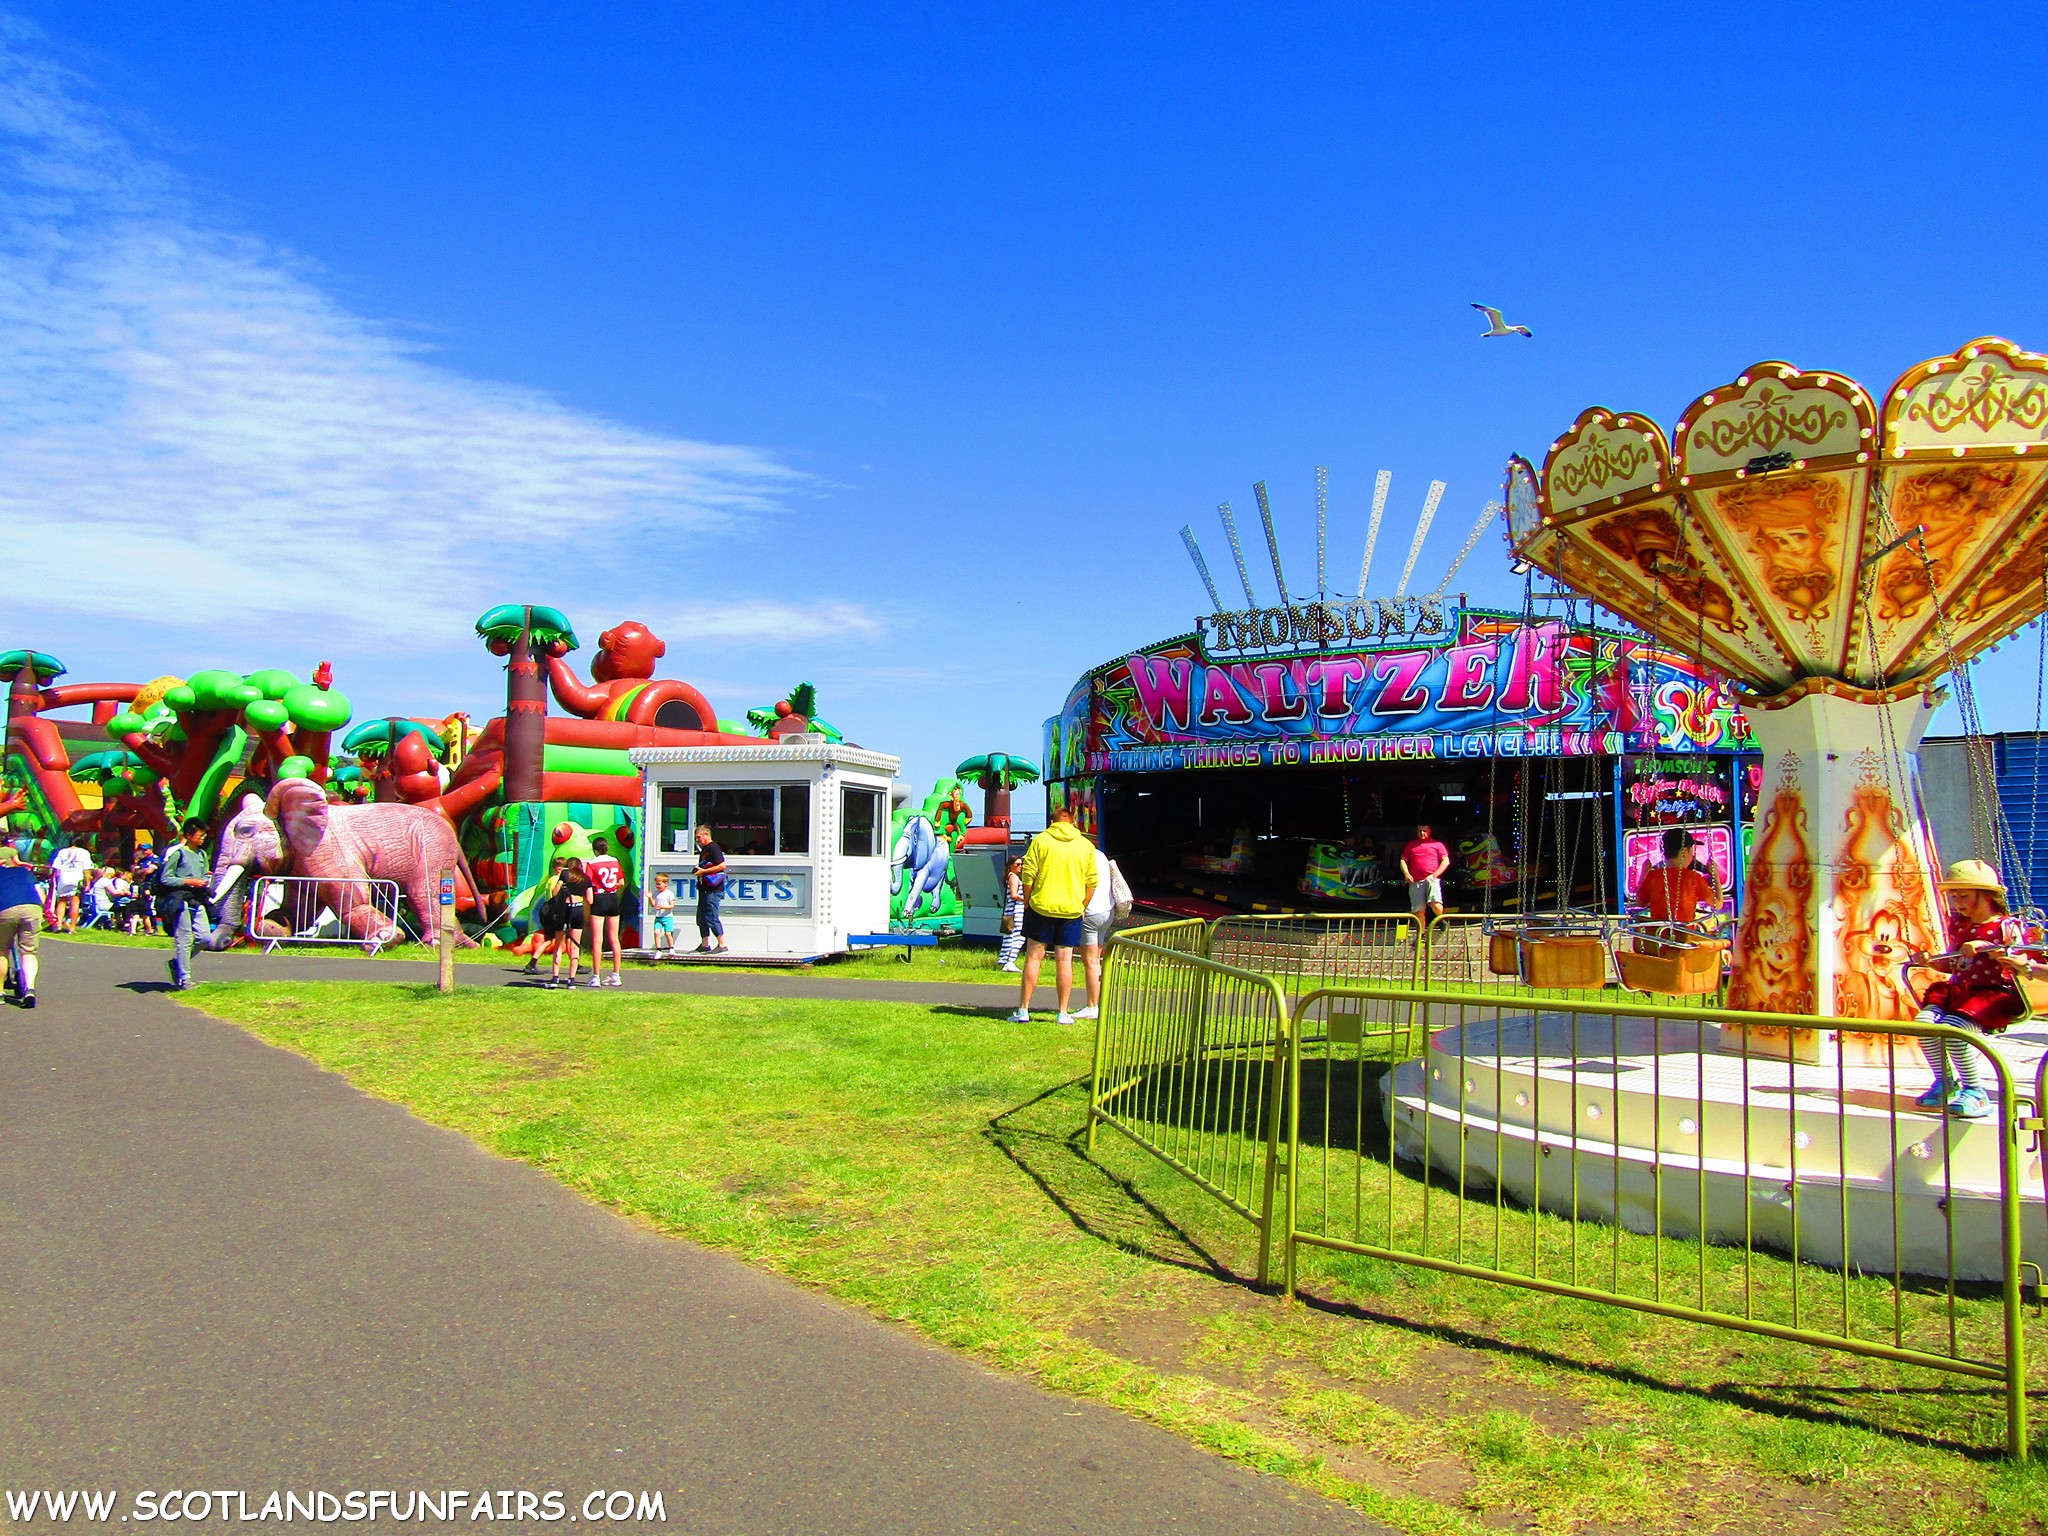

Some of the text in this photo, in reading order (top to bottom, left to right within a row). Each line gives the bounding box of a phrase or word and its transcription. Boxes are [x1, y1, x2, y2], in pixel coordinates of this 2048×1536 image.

[1210, 592, 1443, 651] THOMSON'S
[1126, 620, 1571, 731] WALTZER
[1108, 749, 1174, 771] TAKING
[1180, 743, 1262, 769] THINGS
[1268, 742, 1301, 765] TO
[1309, 736, 1435, 764] ANOTHER
[598, 867, 619, 889] 25
[671, 878, 794, 901] TIKETS
